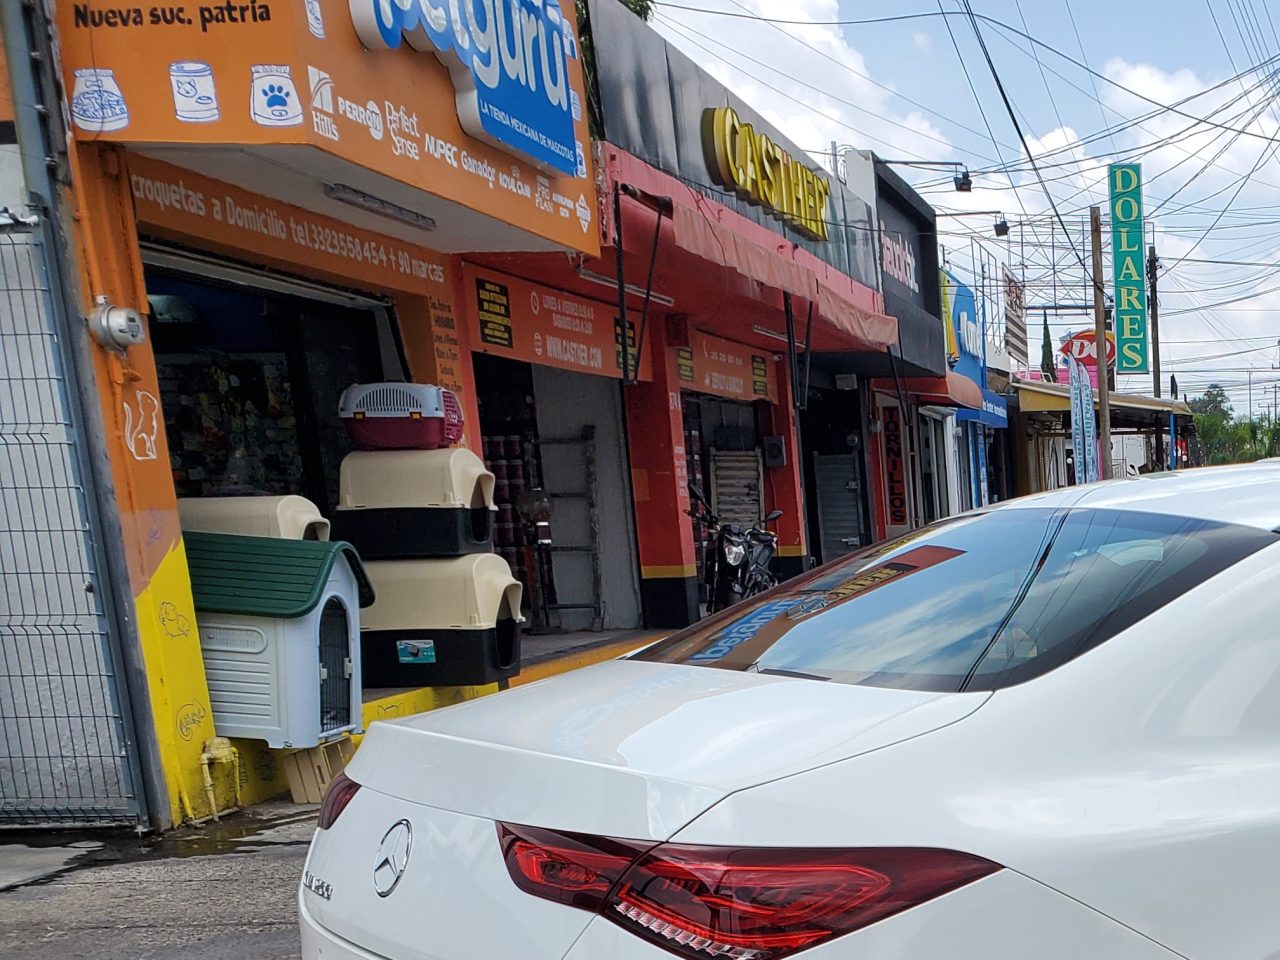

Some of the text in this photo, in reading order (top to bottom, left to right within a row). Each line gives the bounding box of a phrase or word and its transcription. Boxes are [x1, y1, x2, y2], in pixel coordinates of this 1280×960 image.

[74, 1, 271, 32] Nueva suc. patria
[424, 133, 458, 168] NUPEC
[480, 99, 575, 162] LA TIENDA MEXICANA DE MASCOTAS
[701, 107, 829, 241] CASTHER
[130, 173, 206, 217] croquetas
[211, 198, 222, 221] a
[225, 196, 287, 240] Domicilio
[412, 258, 445, 283] marcas
[1114, 168, 1144, 368] DOLARES
